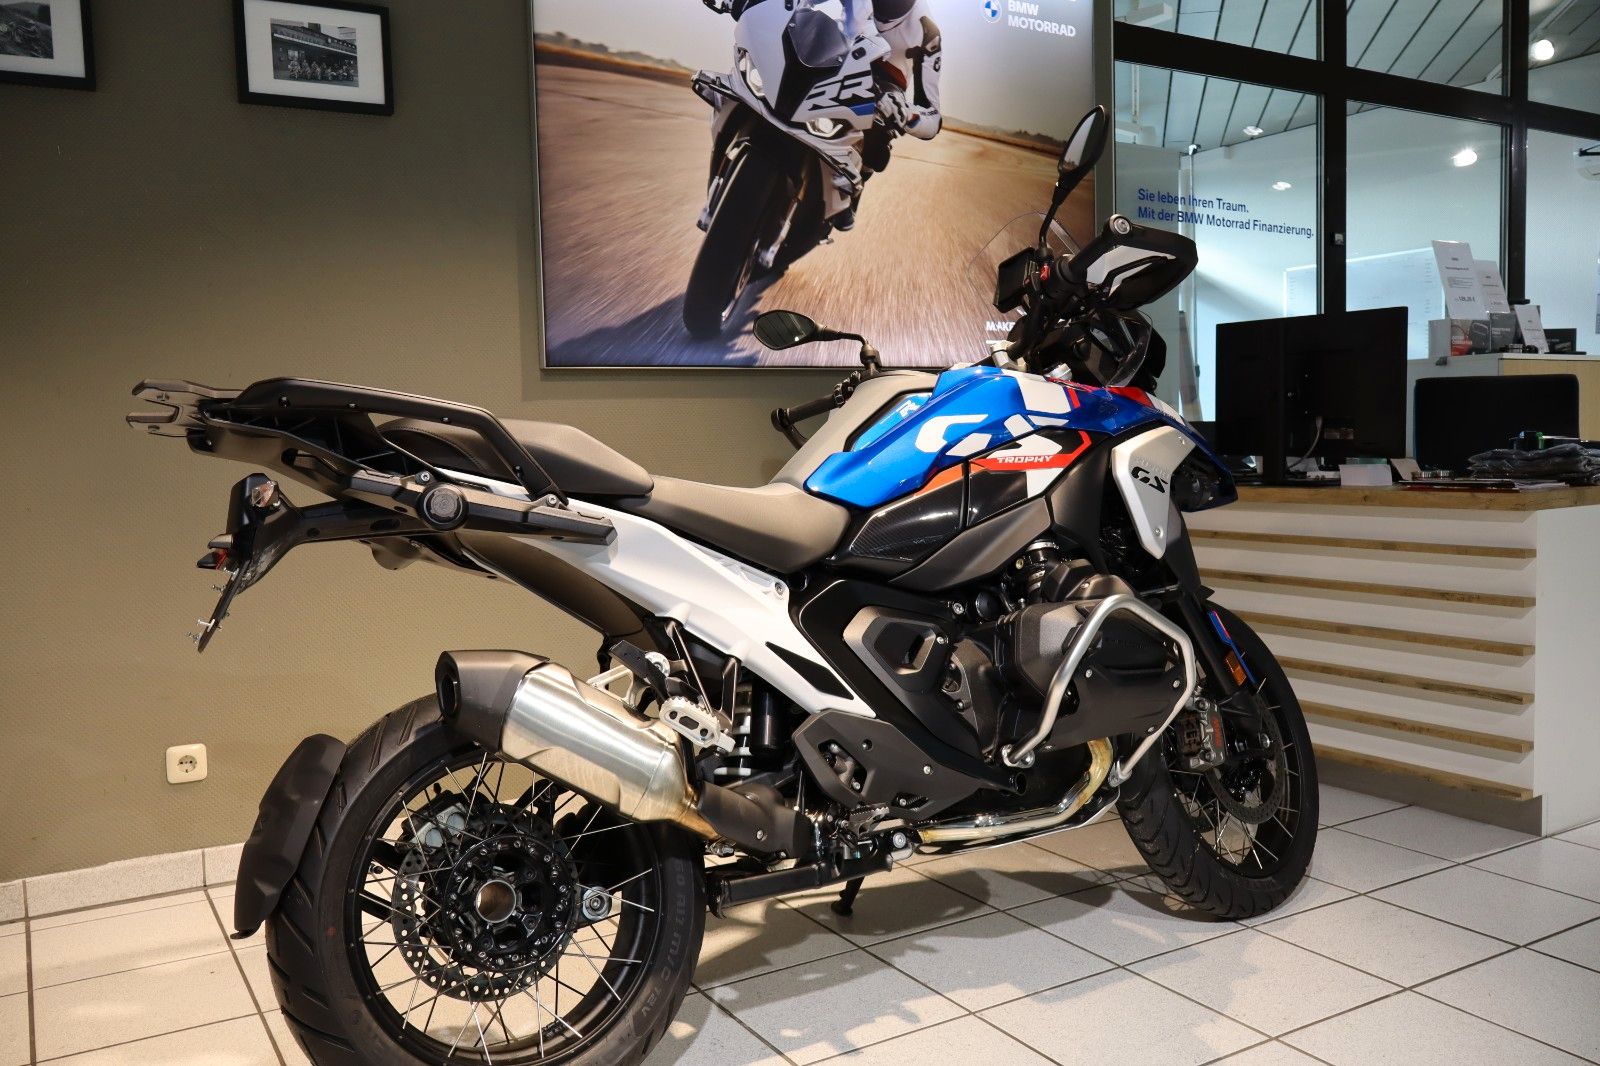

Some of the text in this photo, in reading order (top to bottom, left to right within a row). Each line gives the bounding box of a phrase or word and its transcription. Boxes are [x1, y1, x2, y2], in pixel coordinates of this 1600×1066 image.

[1007, 0, 1040, 15] BMW
[1007, 14, 1076, 37] MOTORRAD
[1137, 188, 1250, 213] Sie leben Ihren Traum.
[1137, 206, 1315, 239] Mit der BMW Motorrad Finanzierung.
[996, 455, 1054, 465] TROPHY
[1130, 466, 1169, 494] GS
